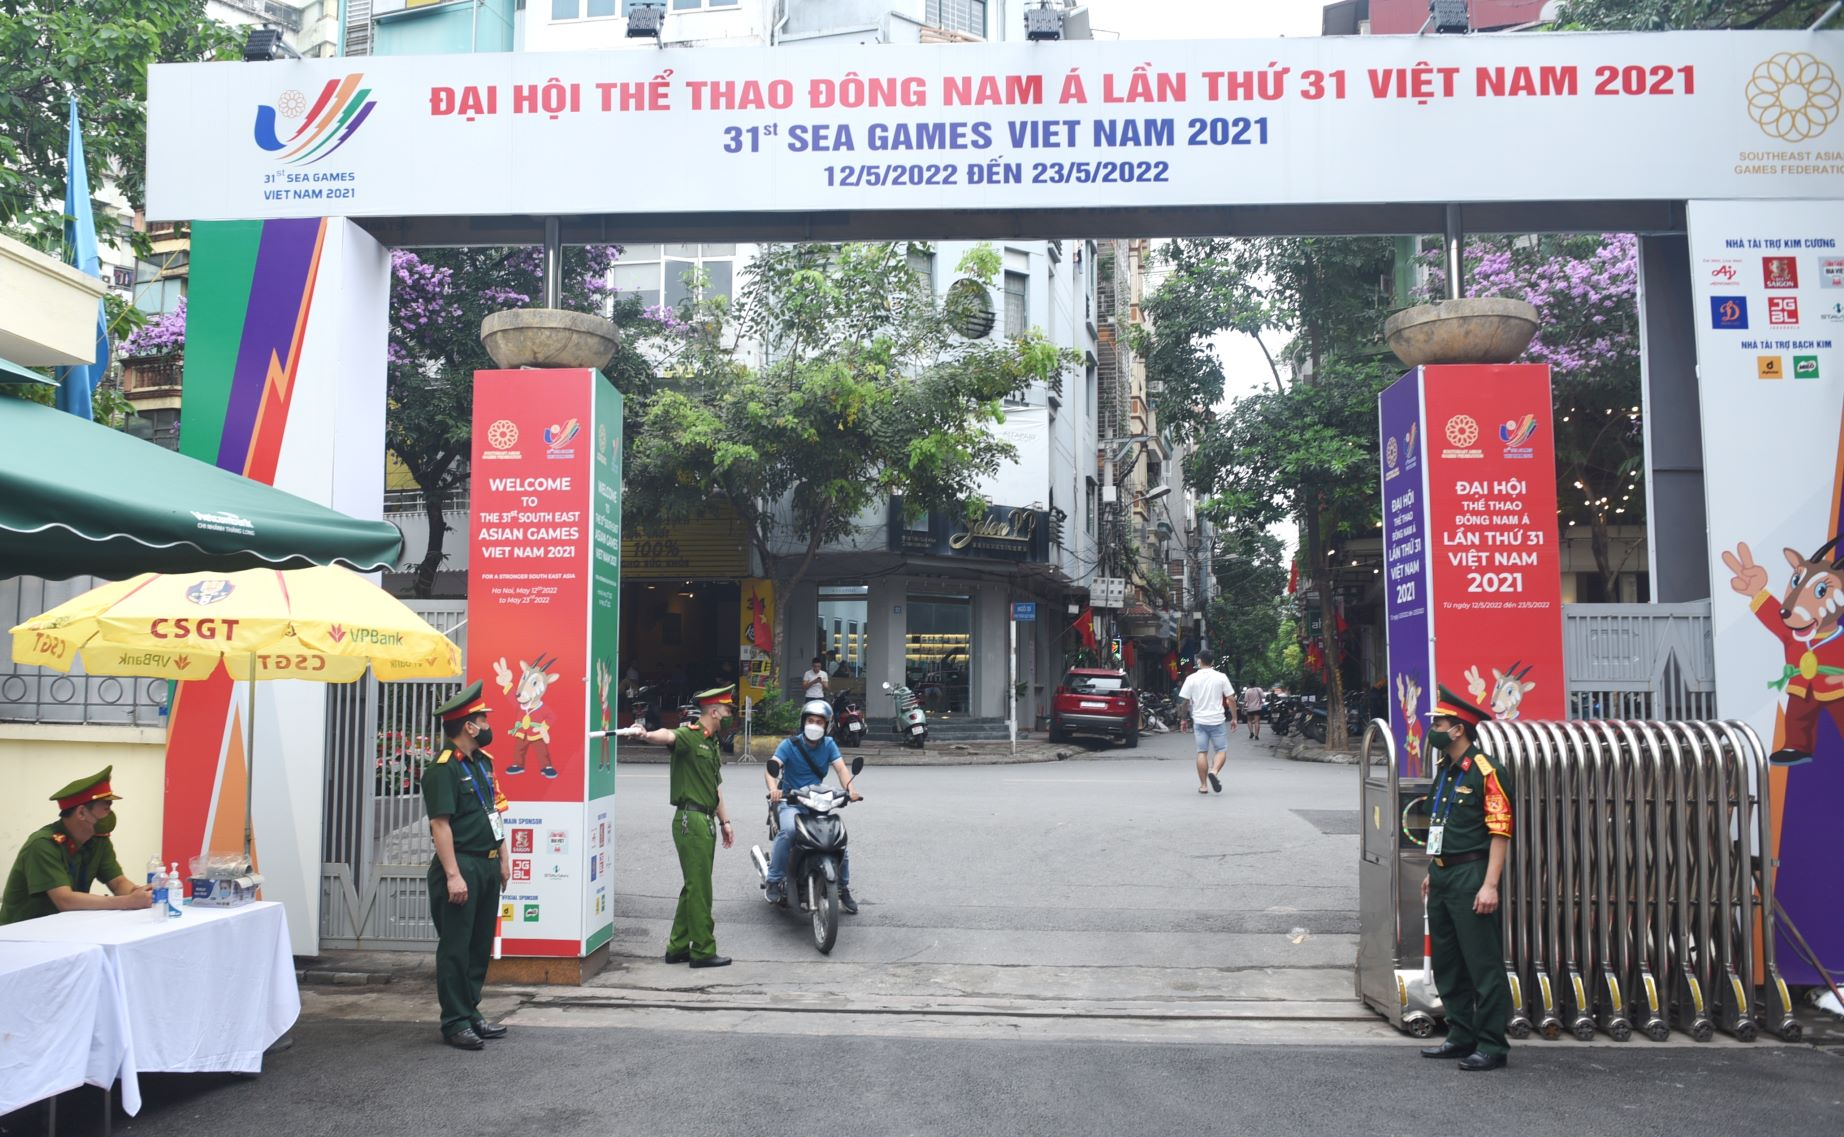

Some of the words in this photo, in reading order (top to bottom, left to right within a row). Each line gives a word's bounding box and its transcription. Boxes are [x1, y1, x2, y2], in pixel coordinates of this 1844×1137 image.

[429, 86, 497, 122] ĐẠI
[513, 78, 580, 120] HỘI
[596, 69, 674, 112] THỂ
[686, 80, 794, 110] THAO
[808, 72, 926, 108] ĐÔNG
[944, 75, 1042, 106] NAM
[1059, 68, 1088, 104] Á
[1103, 62, 1186, 104] LẦN
[1202, 61, 1290, 101] THỨ
[1300, 70, 1346, 100] 31
[1368, 61, 1460, 105] VIỆT
[1476, 66, 1577, 97] NAM
[1594, 64, 1694, 96] 2021
[724, 122, 778, 153] 31st
[788, 124, 855, 152] SEA
[868, 121, 992, 151] GAMES
[1008, 120, 1080, 149] VIET
[1094, 118, 1174, 148] NAM
[1188, 117, 1268, 146] 2021
[1739, 152, 1811, 161] SOUTHEAST
[1815, 152, 1844, 160] ASIA
[264, 169, 284, 184] 31st
[286, 174, 310, 182] SEA
[312, 172, 355, 182] GAMES
[824, 164, 957, 186] 12/5/2022
[967, 155, 1022, 184] ĐẾN
[1032, 161, 1169, 184] 23/5/2022
[1734, 164, 1777, 174] GAMES
[264, 190, 290, 200] VIET
[293, 189, 322, 200] NAM
[326, 188, 355, 198] 2021
[1726, 237, 1744, 248] NHÀ
[1748, 237, 1761, 248] TÀI
[1764, 238, 1781, 250] TRỢ
[1784, 239, 1801, 248] KIM
[1741, 340, 1758, 349] NHÀ
[1760, 340, 1772, 349] TÀI
[1776, 340, 1790, 351] TRỢ
[1793, 341, 1814, 350] BẠCH
[1816, 340, 1832, 348] KIM
[489, 477, 571, 491] WELCOME
[1456, 481, 1488, 498] ĐẠI
[1494, 478, 1526, 498] HỘI
[521, 496, 538, 507] TO
[1392, 496, 1402, 514] ĐẠI
[1403, 488, 1414, 508] HỘI
[1488, 501, 1522, 510] THAO
[480, 512, 499, 522] THE
[518, 512, 552, 522] SOUTH
[555, 512, 580, 522] EAST
[1456, 513, 1489, 525] ĐÔNG
[1493, 516, 1518, 524] NAM
[1522, 513, 1530, 524] Á
[478, 528, 523, 540] ASIAN
[527, 527, 579, 540] GAMES
[1443, 527, 1479, 545] LẦN
[1484, 528, 1523, 545] THỨ
[1527, 531, 1544, 544] 31
[482, 547, 511, 558] VIET
[514, 547, 544, 557] NAM
[547, 546, 575, 557] 2021
[1415, 538, 1421, 553] 31
[1448, 549, 1489, 569] VIỆT
[1495, 552, 1537, 566] NAM
[1391, 563, 1404, 582] VIỆT
[1404, 560, 1419, 577] NAM
[1467, 572, 1522, 592] 2021
[1396, 581, 1415, 604] 2021
[150, 618, 240, 641] CSGT
[350, 628, 404, 646] VPBank
